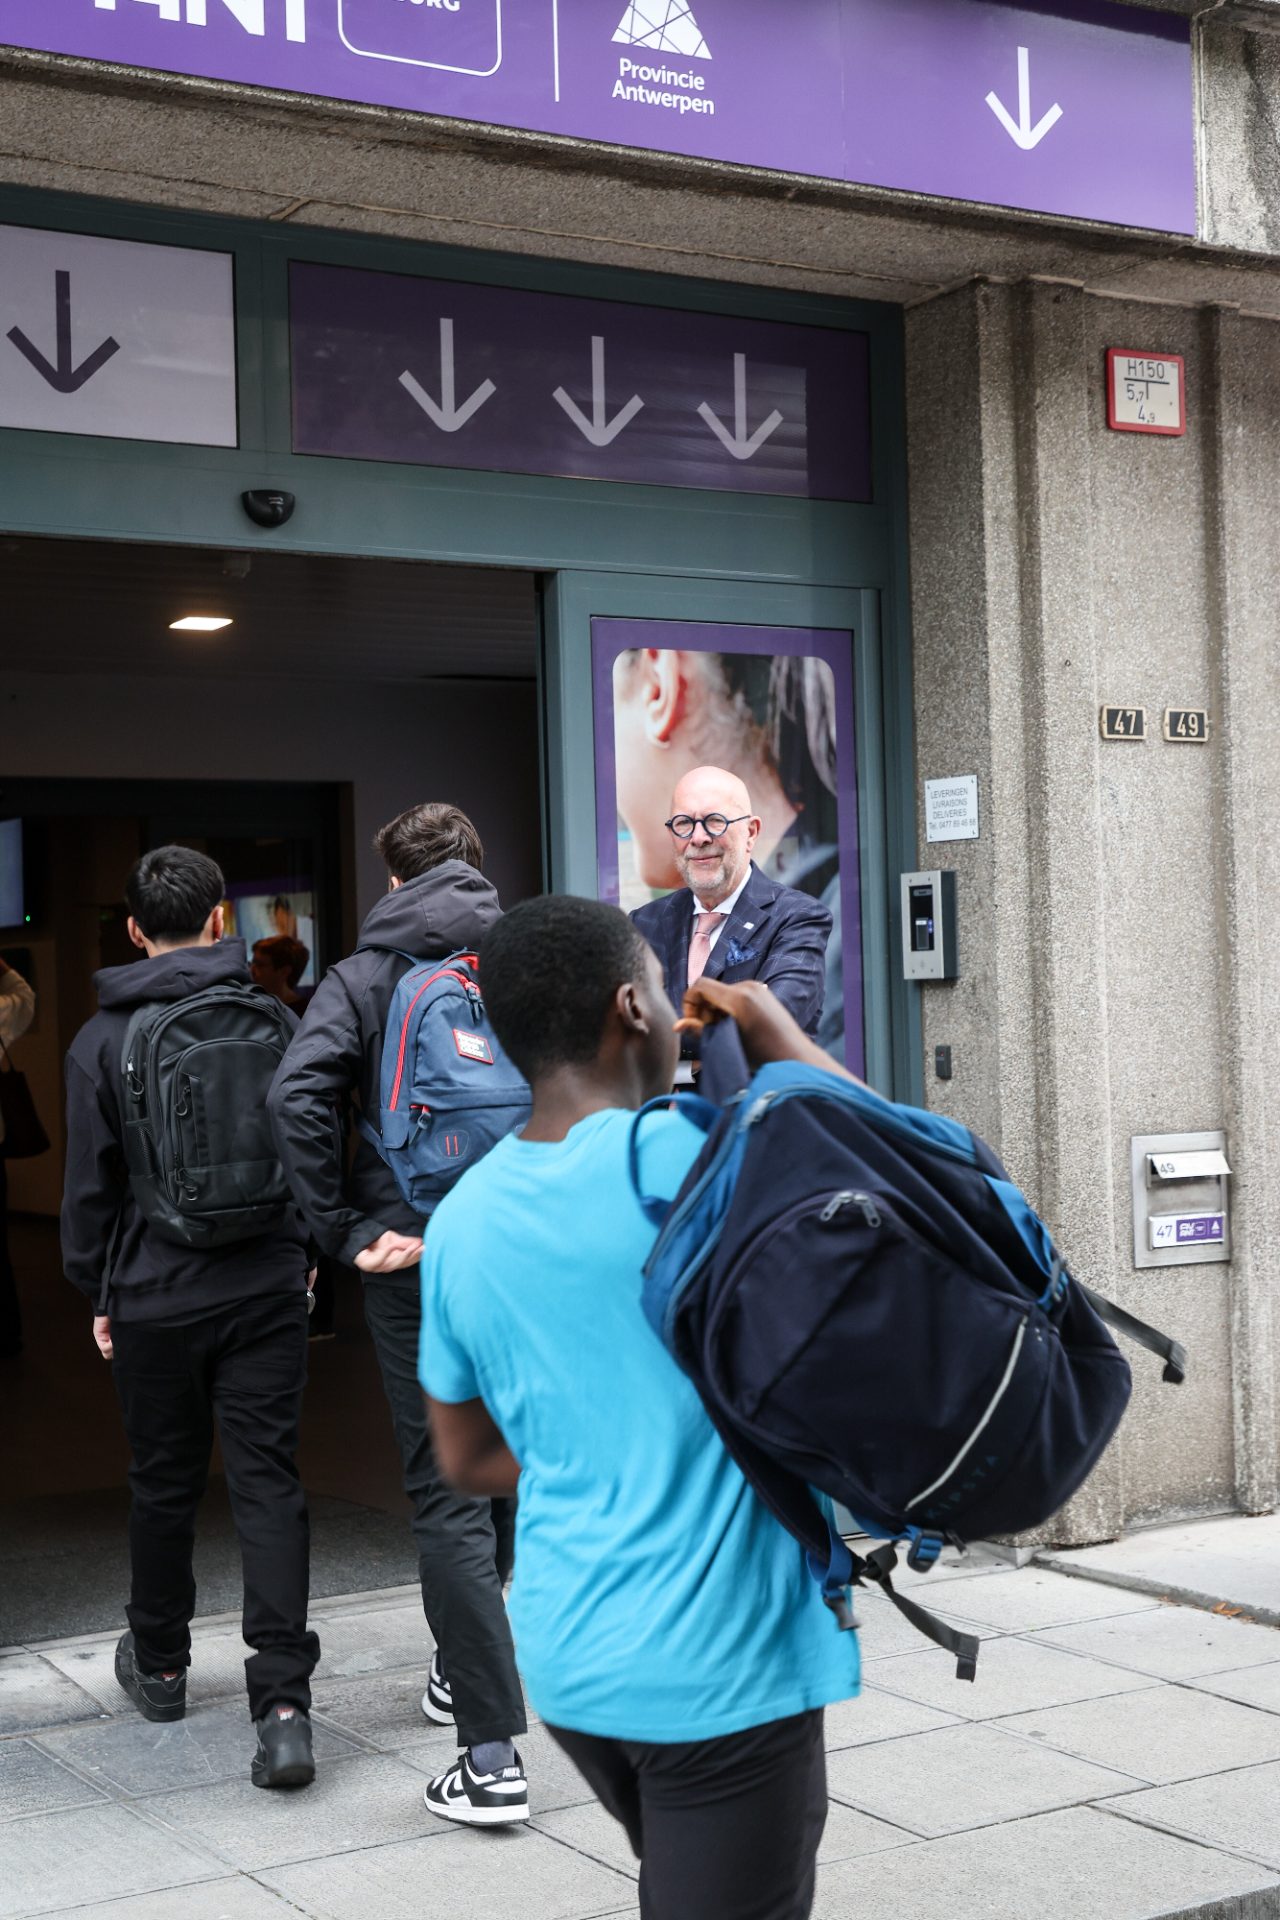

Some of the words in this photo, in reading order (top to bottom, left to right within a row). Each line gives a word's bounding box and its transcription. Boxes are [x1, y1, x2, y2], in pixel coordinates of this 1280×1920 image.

[619, 57, 705, 91] Provincie
[612, 79, 715, 115] Antwerpen
[1127, 358, 1165, 379] H150
[1114, 710, 1137, 734] 47
[1176, 712, 1199, 736] 49
[931, 787, 968, 800] LEVERINGEN
[933, 808, 967, 820] DELIVERIES
[1160, 1162, 1175, 1174] 49
[1156, 1225, 1173, 1238] 47
